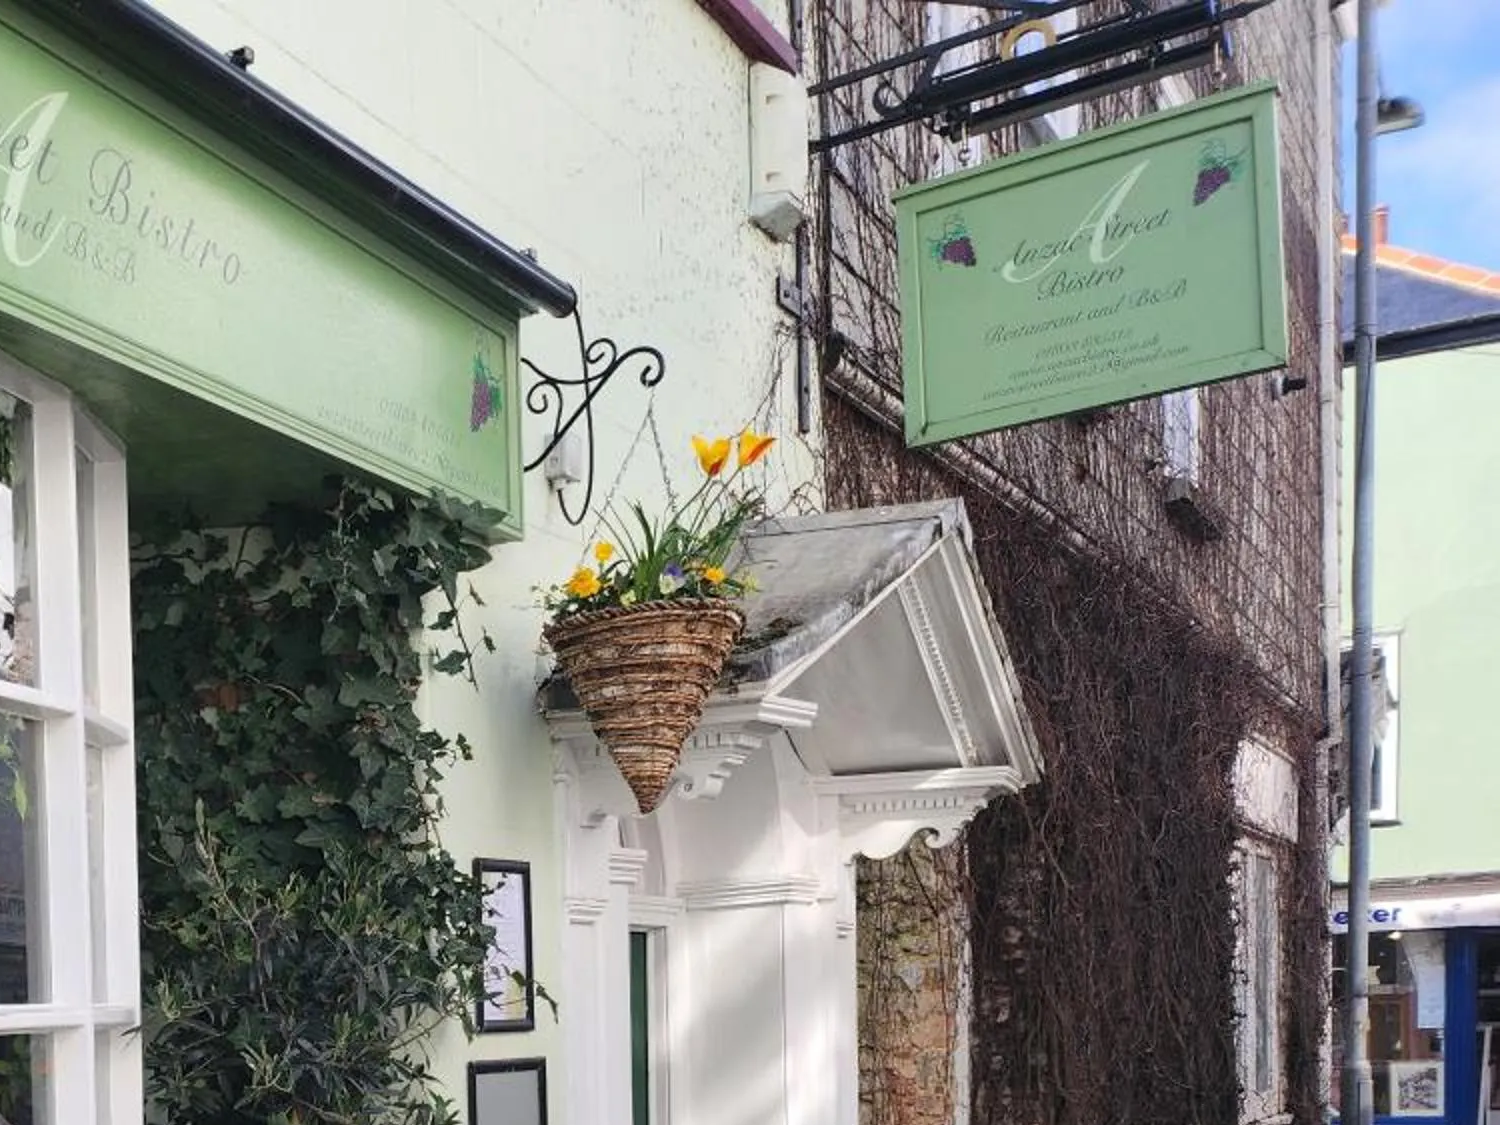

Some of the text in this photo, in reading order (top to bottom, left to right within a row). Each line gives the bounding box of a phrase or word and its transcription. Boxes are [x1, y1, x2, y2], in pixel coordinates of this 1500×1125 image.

[90, 149, 241, 284] Bistro
[993, 208, 1172, 272] Anzac Street
[63, 221, 136, 284] B&B
[1037, 265, 1125, 301] Bistro
[984, 312, 1082, 344] Restaurant
[1087, 300, 1122, 320] and
[1334, 907, 1402, 925] eer
